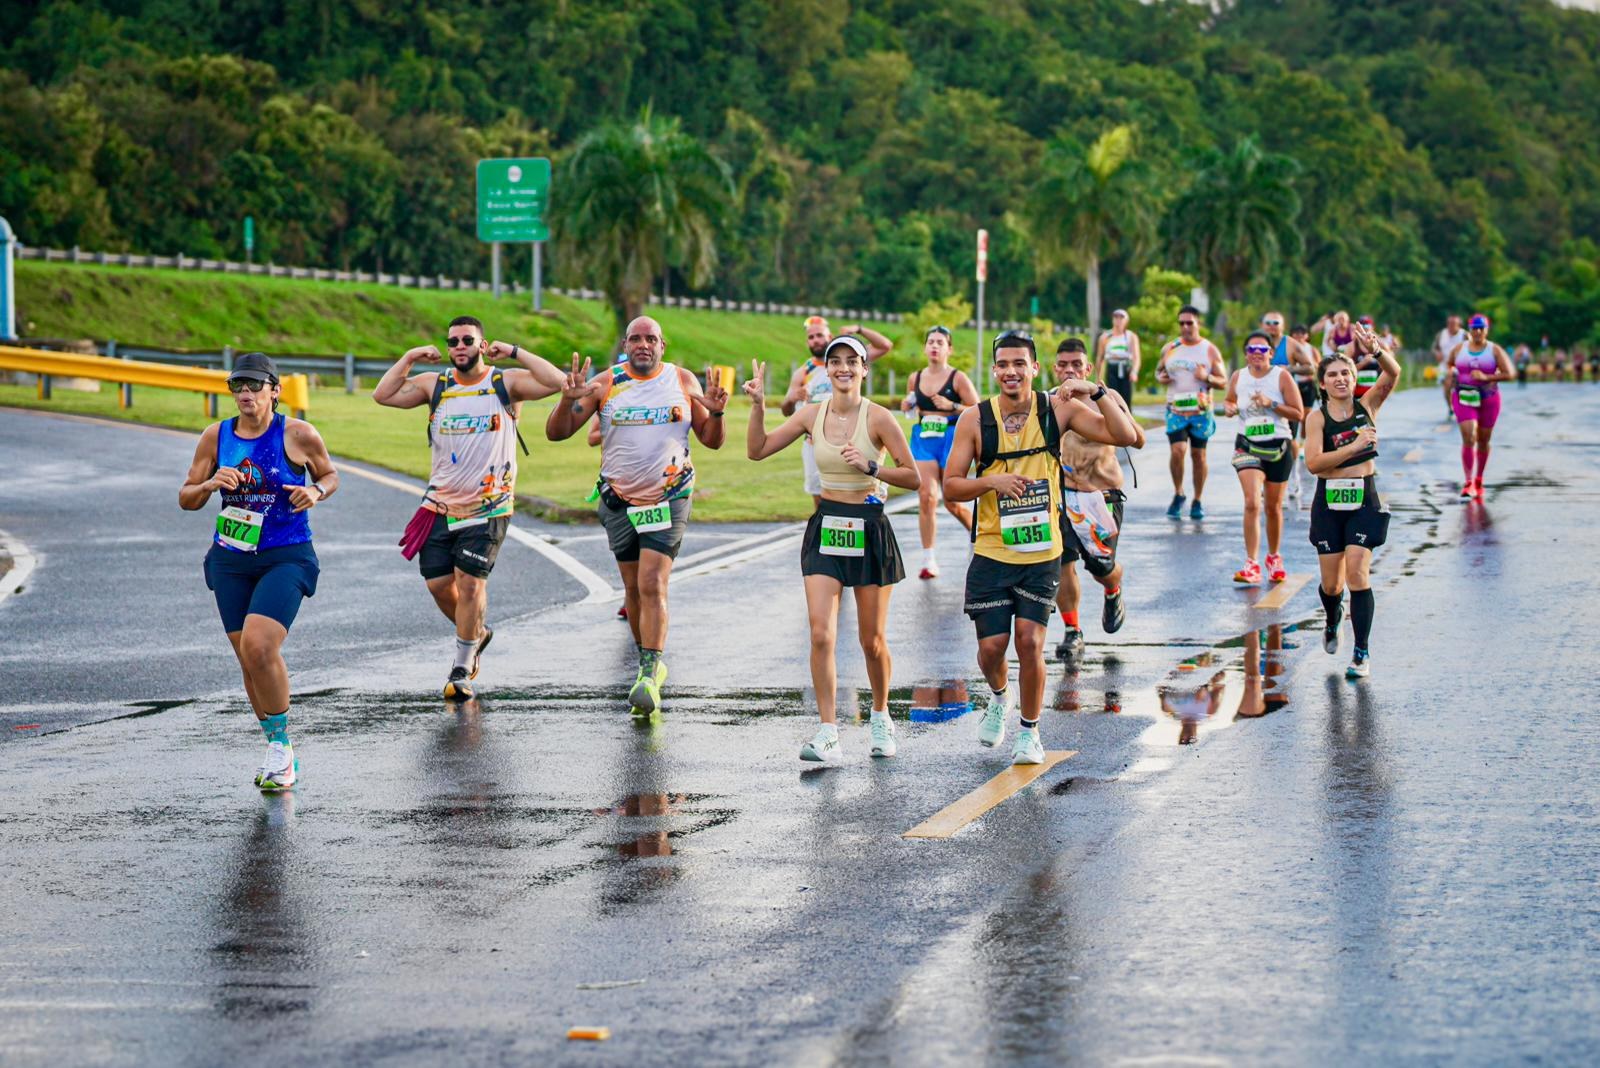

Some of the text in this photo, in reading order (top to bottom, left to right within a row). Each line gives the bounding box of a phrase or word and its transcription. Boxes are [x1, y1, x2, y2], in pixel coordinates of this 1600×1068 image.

[612, 408, 647, 420] CHE
[244, 493, 277, 503] RUNNERS
[1000, 495, 1049, 509] FINISHER
[1332, 489, 1357, 503] 268
[635, 508, 663, 526] 283
[223, 519, 252, 541] 677
[1012, 525, 1043, 545] 135
[829, 529, 855, 548] 350
